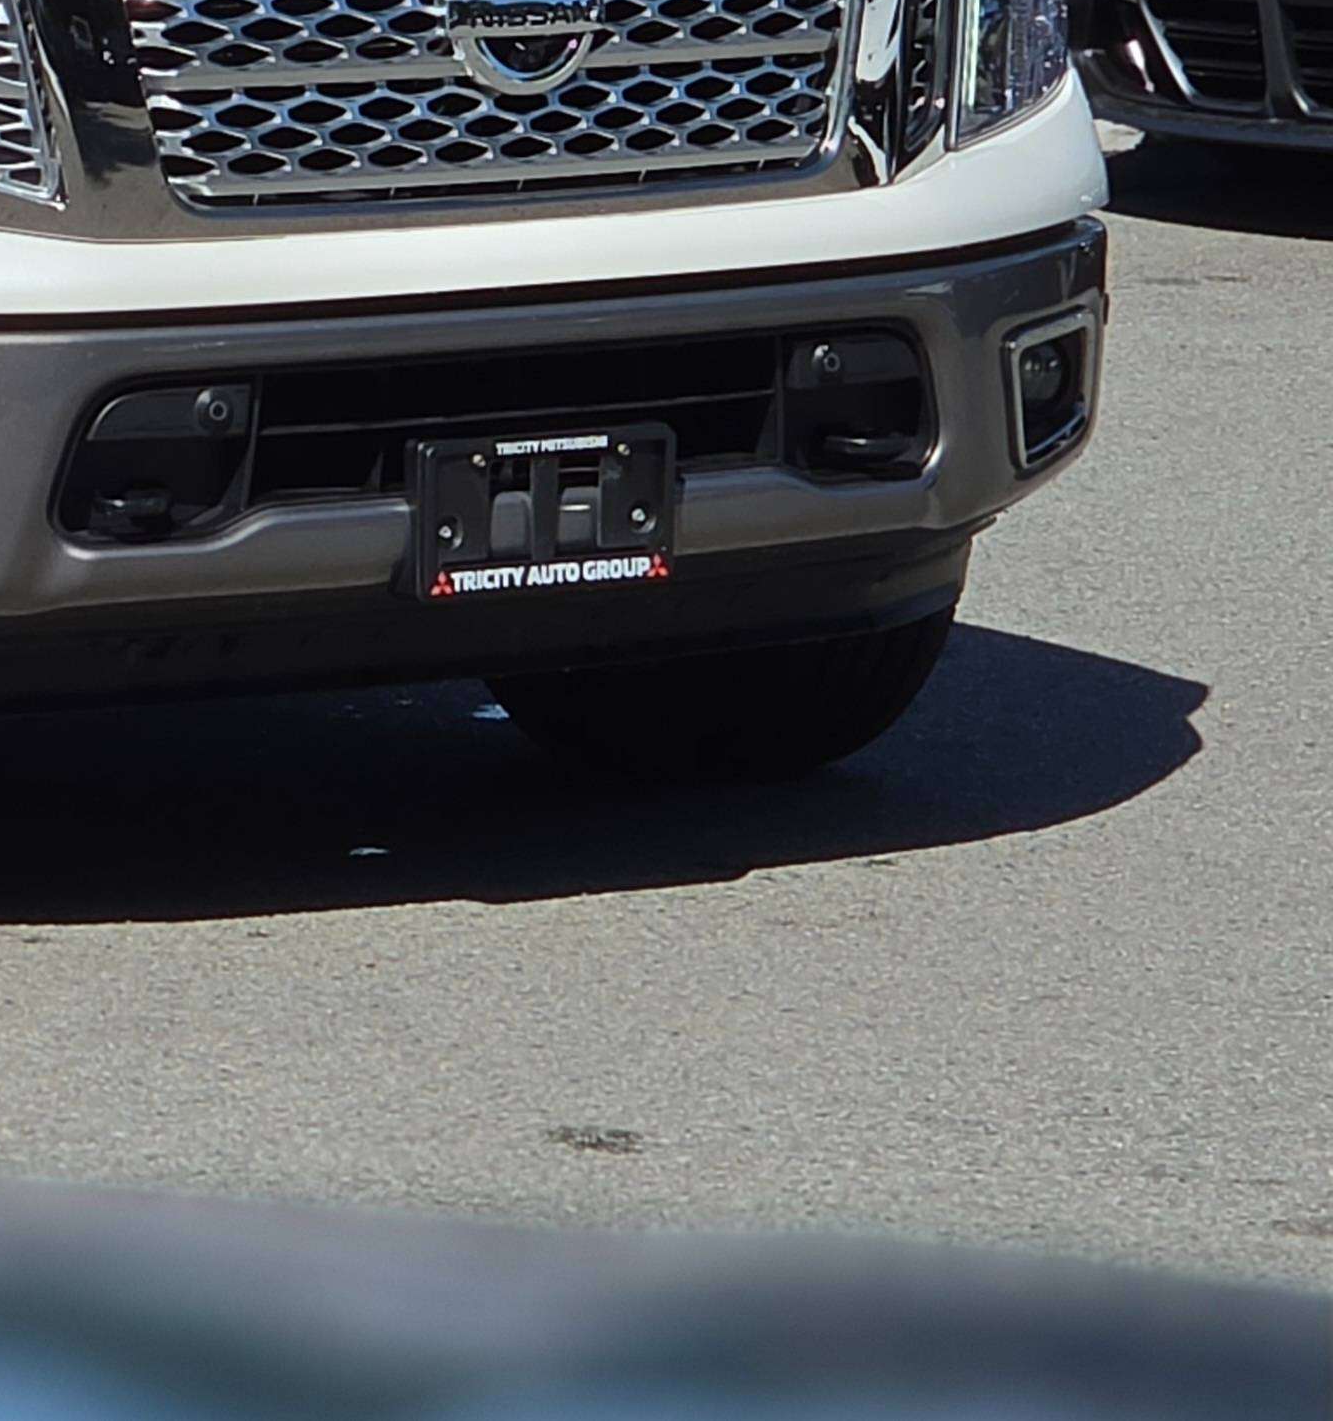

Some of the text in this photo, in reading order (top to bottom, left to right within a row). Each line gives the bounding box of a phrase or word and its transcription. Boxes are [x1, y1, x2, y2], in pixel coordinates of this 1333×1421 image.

[450, 555, 652, 592] TRICITY AUTO GROUP
